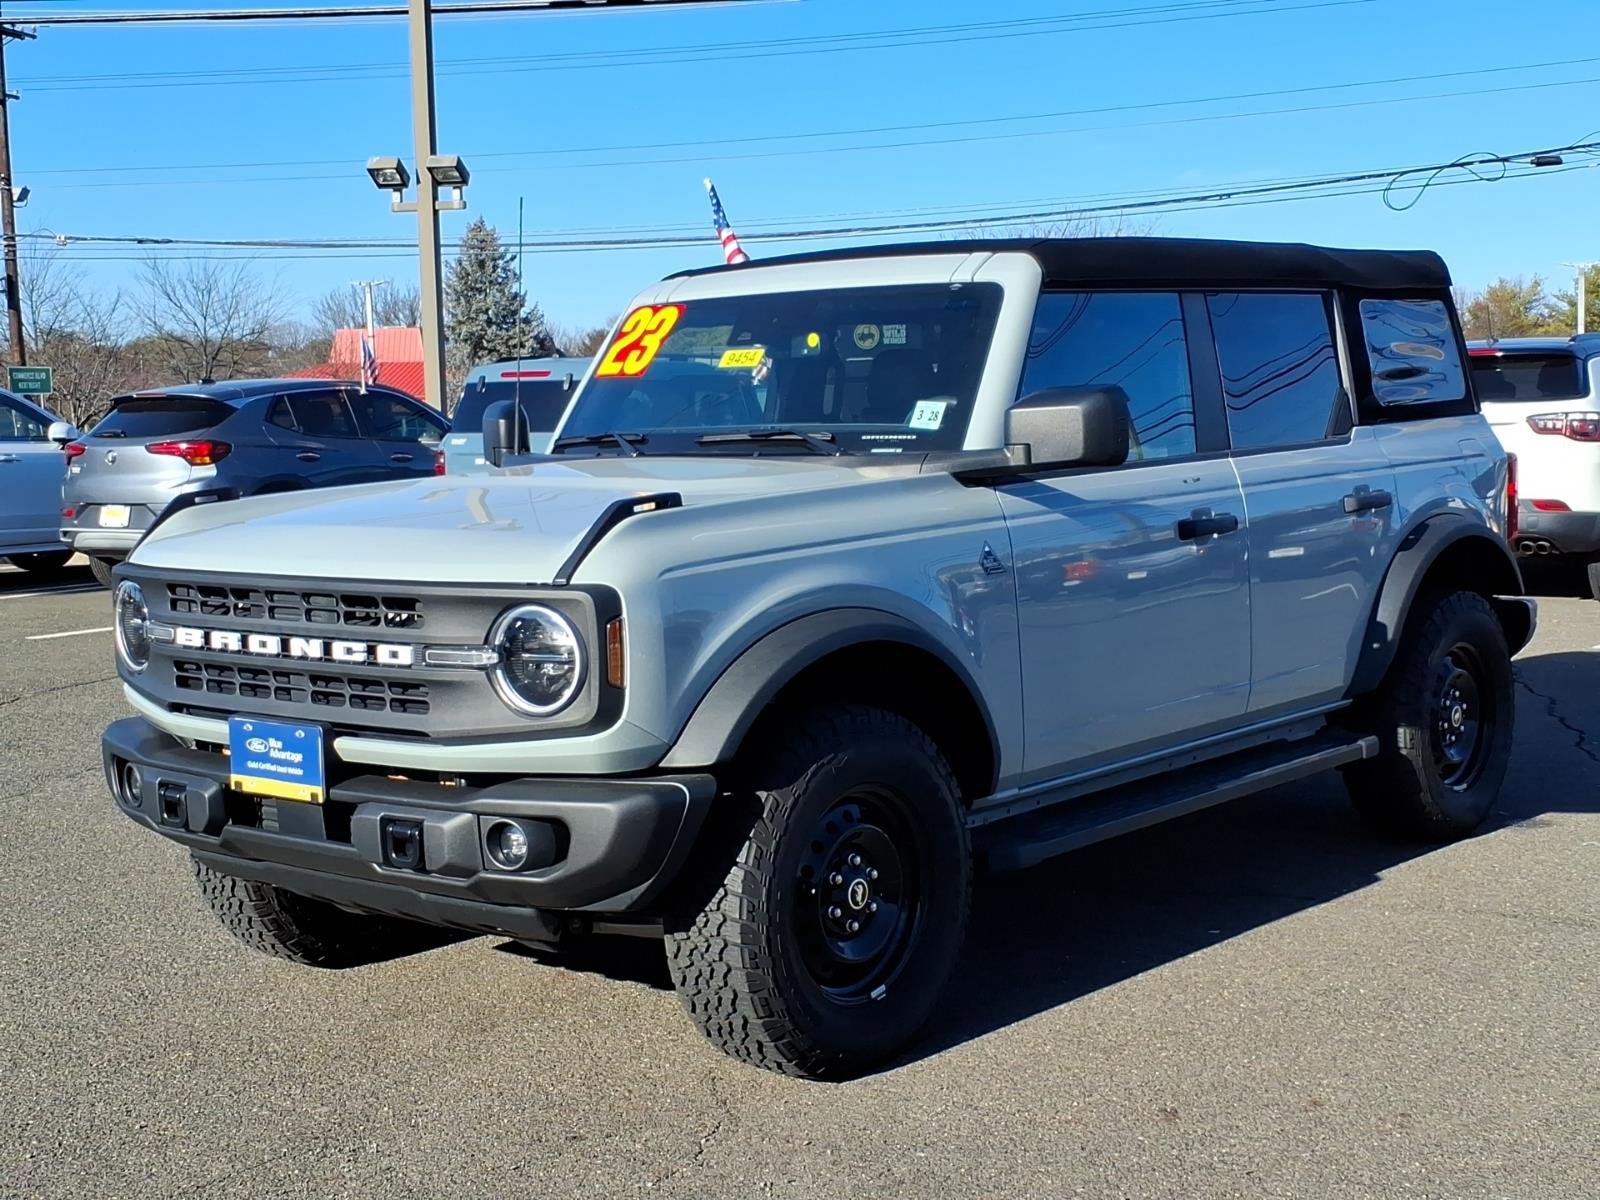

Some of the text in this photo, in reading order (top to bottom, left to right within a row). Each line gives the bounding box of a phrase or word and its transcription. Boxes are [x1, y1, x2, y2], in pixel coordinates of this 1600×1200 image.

[596, 305, 679, 375] 23
[883, 330, 906, 338] WILD
[726, 351, 758, 365] 9454
[917, 410, 924, 420] 3
[175, 627, 413, 665] BRONCO
[269, 748, 303, 763] Advantage
